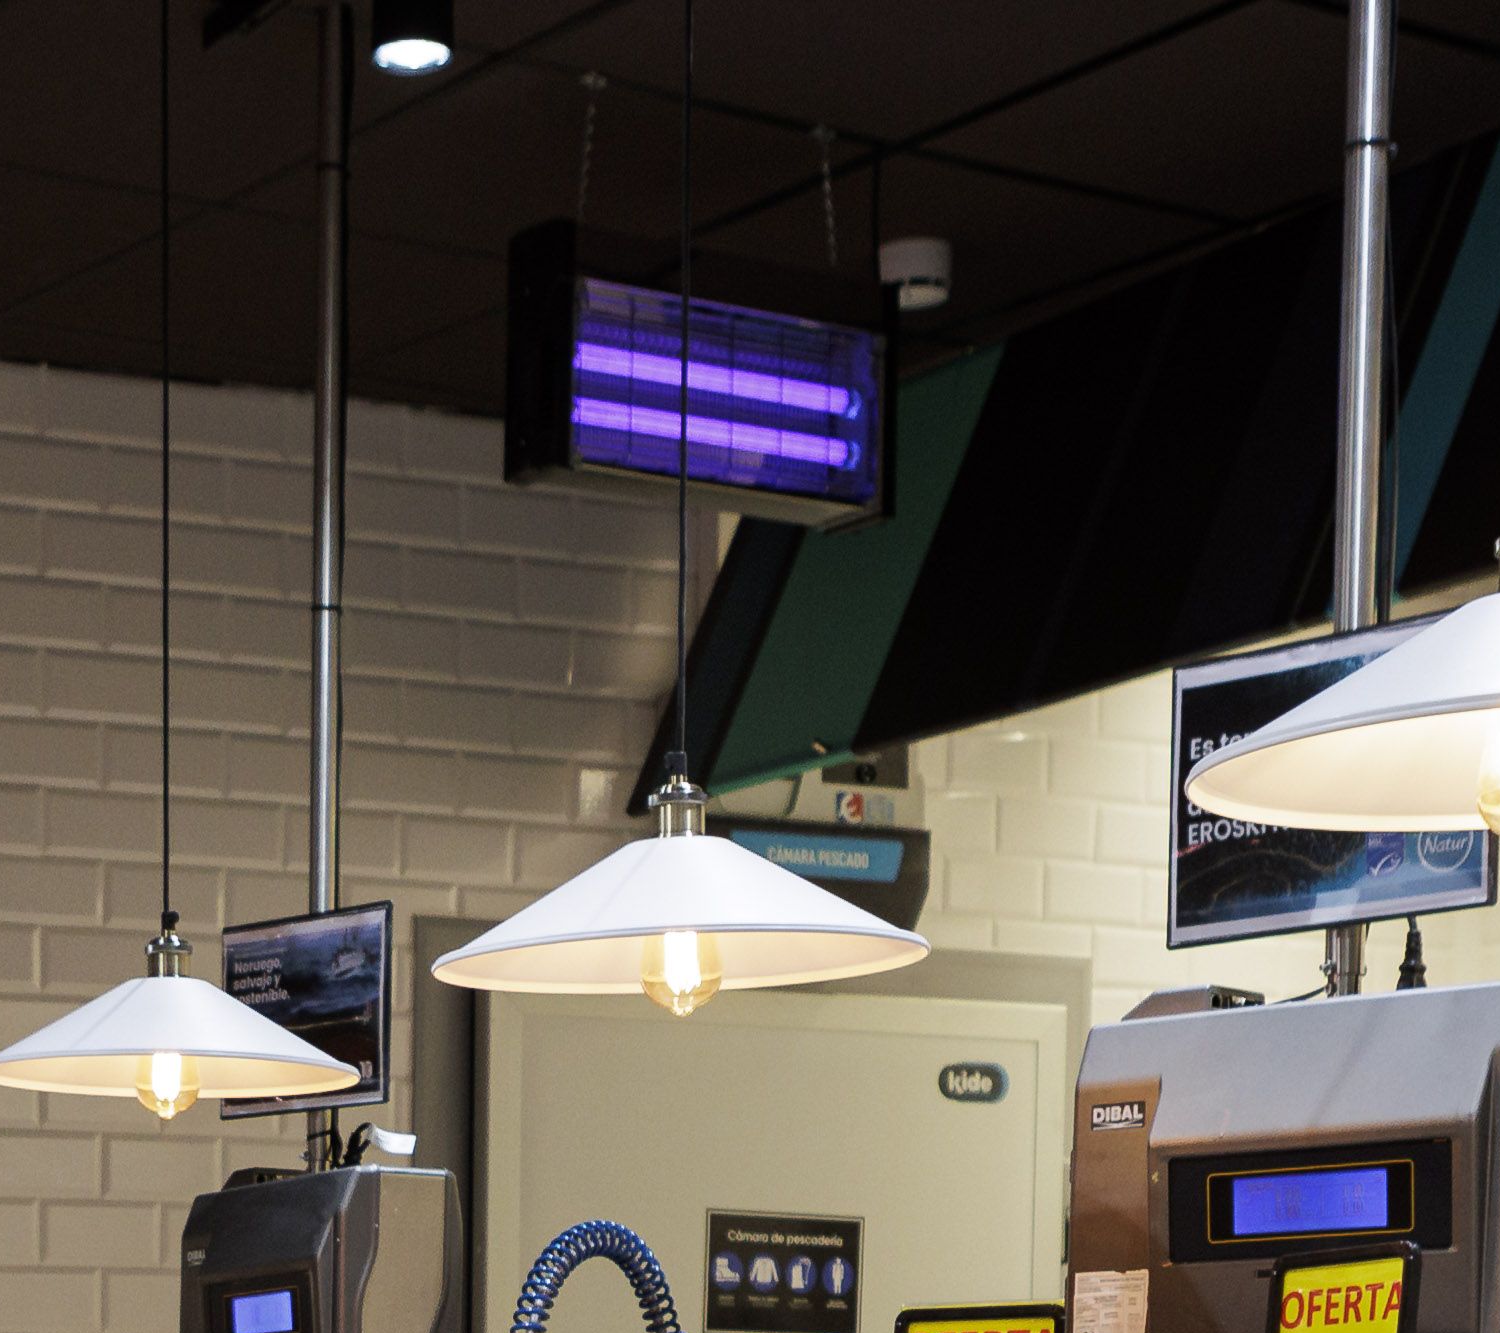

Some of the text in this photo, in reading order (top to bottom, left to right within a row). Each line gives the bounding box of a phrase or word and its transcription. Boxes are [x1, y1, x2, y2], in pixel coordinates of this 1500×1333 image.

[1424, 837, 1466, 855] Natur
[819, 850, 870, 870] PESCADO
[947, 1070, 993, 1094] kide
[1093, 1106, 1143, 1125] DIBAL
[727, 1229, 843, 1248] Cámara de pescadería
[1281, 1281, 1402, 1330] OFERTA
